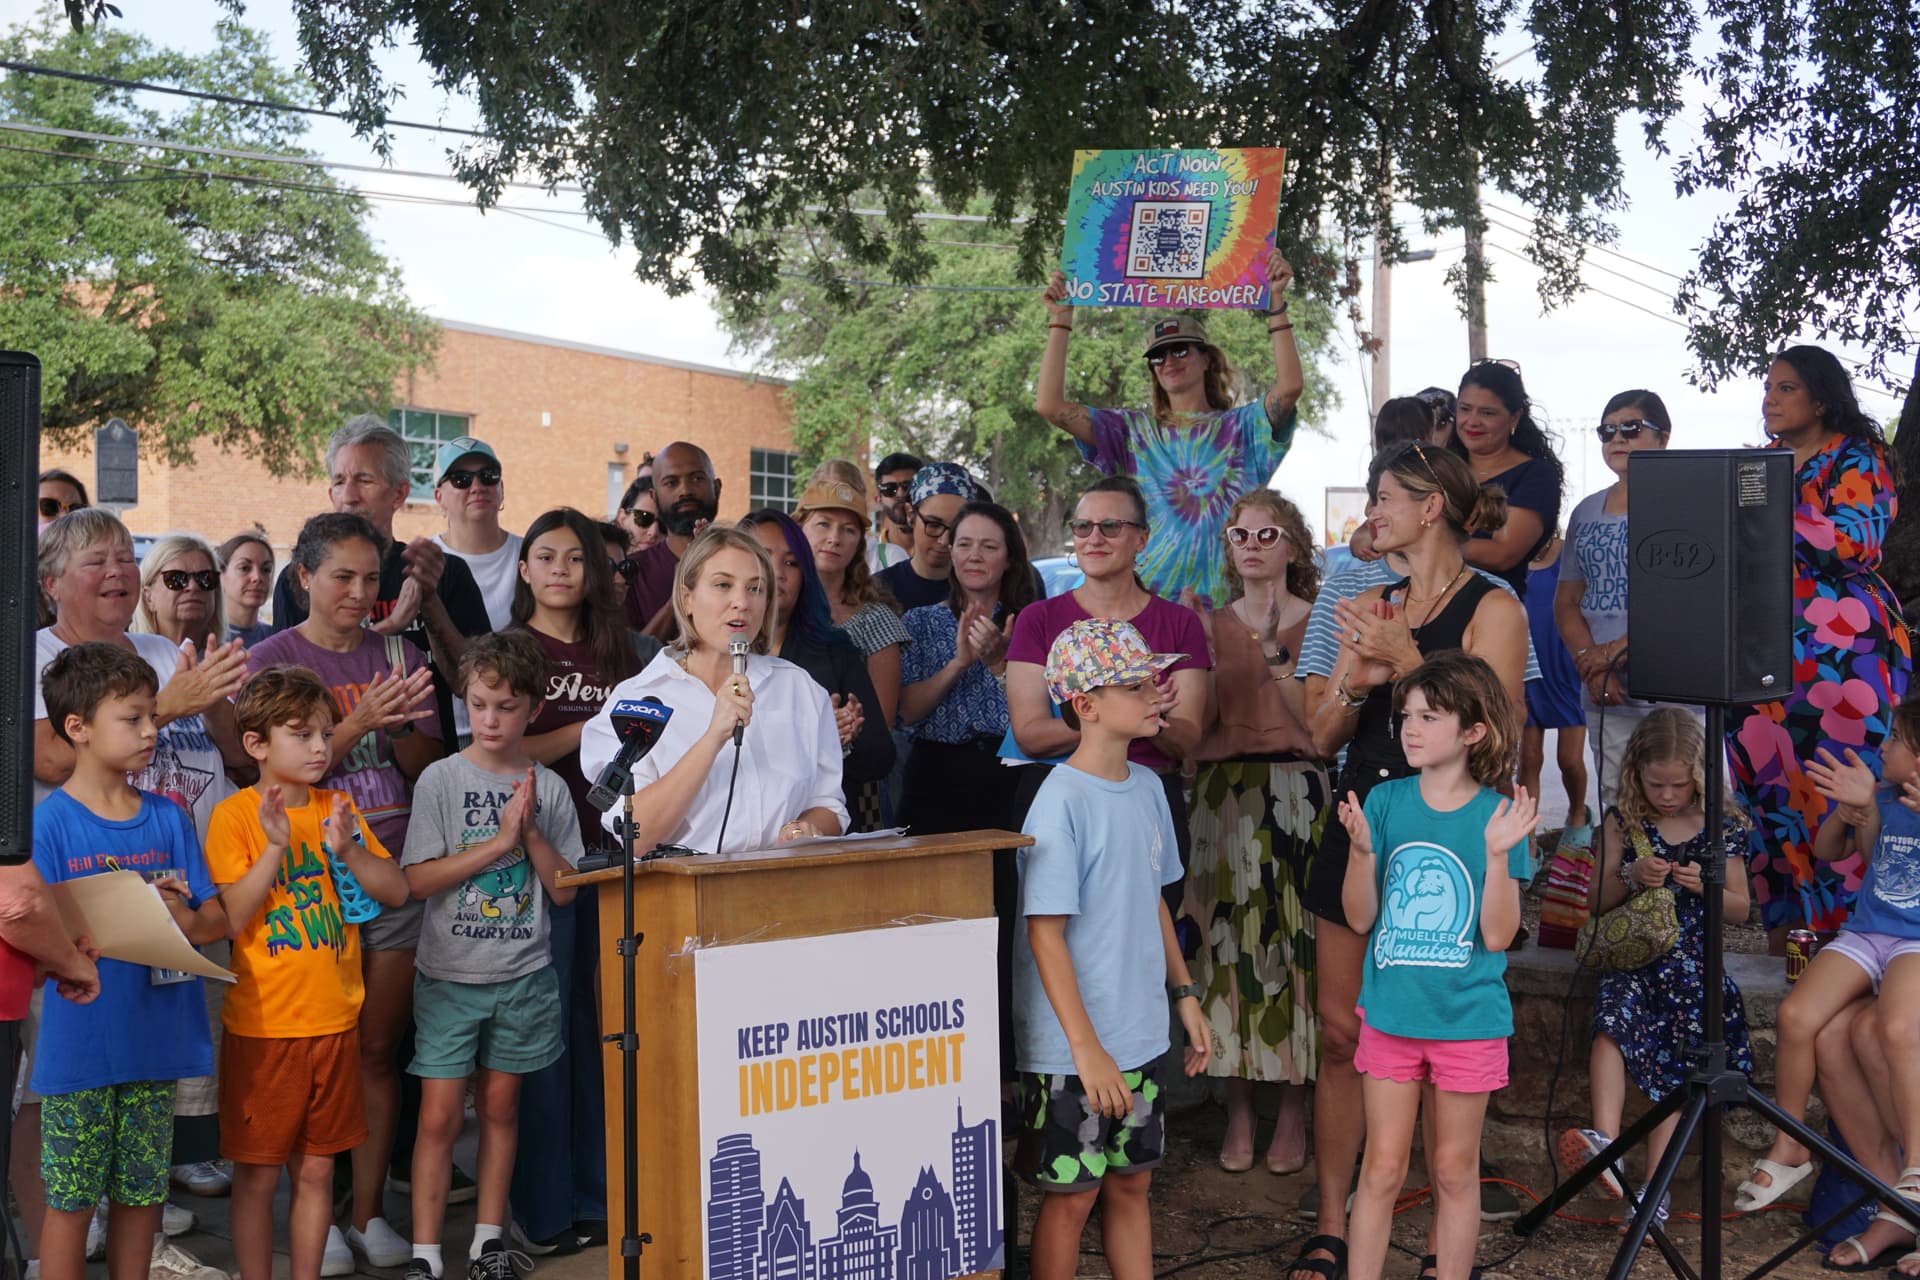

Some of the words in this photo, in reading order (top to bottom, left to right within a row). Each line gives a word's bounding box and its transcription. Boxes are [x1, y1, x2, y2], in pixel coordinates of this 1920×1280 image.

[1134, 153, 1175, 174] ACT
[1178, 154, 1222, 173] NOW
[1091, 180, 1145, 197] AUSTIN
[1148, 180, 1181, 198] KIDS
[1184, 181, 1219, 197] NEED
[1223, 178, 1259, 199] YOU!
[1064, 277, 1094, 299] NO
[1097, 283, 1158, 304] STATE
[1164, 284, 1264, 306] TAKEOVER!
[1580, 521, 1616, 536] LIKE
[1618, 520, 1628, 533] M
[1575, 545, 1628, 563] NIONI
[1590, 576, 1628, 595] ILDR
[1581, 594, 1628, 611] DUCAT
[68, 857, 93, 873] Hill
[286, 880, 323, 911] DO
[454, 911, 478, 922] AND
[265, 905, 303, 951] IS
[451, 923, 510, 939] CARRY
[510, 926, 534, 940] ON
[1397, 930, 1457, 943] MUELLER
[1377, 928, 1472, 963] Manatees
[738, 1022, 789, 1060] KEEP
[797, 1011, 869, 1051] AUSTIN
[875, 998, 965, 1040] SCHOOLS
[738, 1032, 966, 1118] INDEPENDENT
